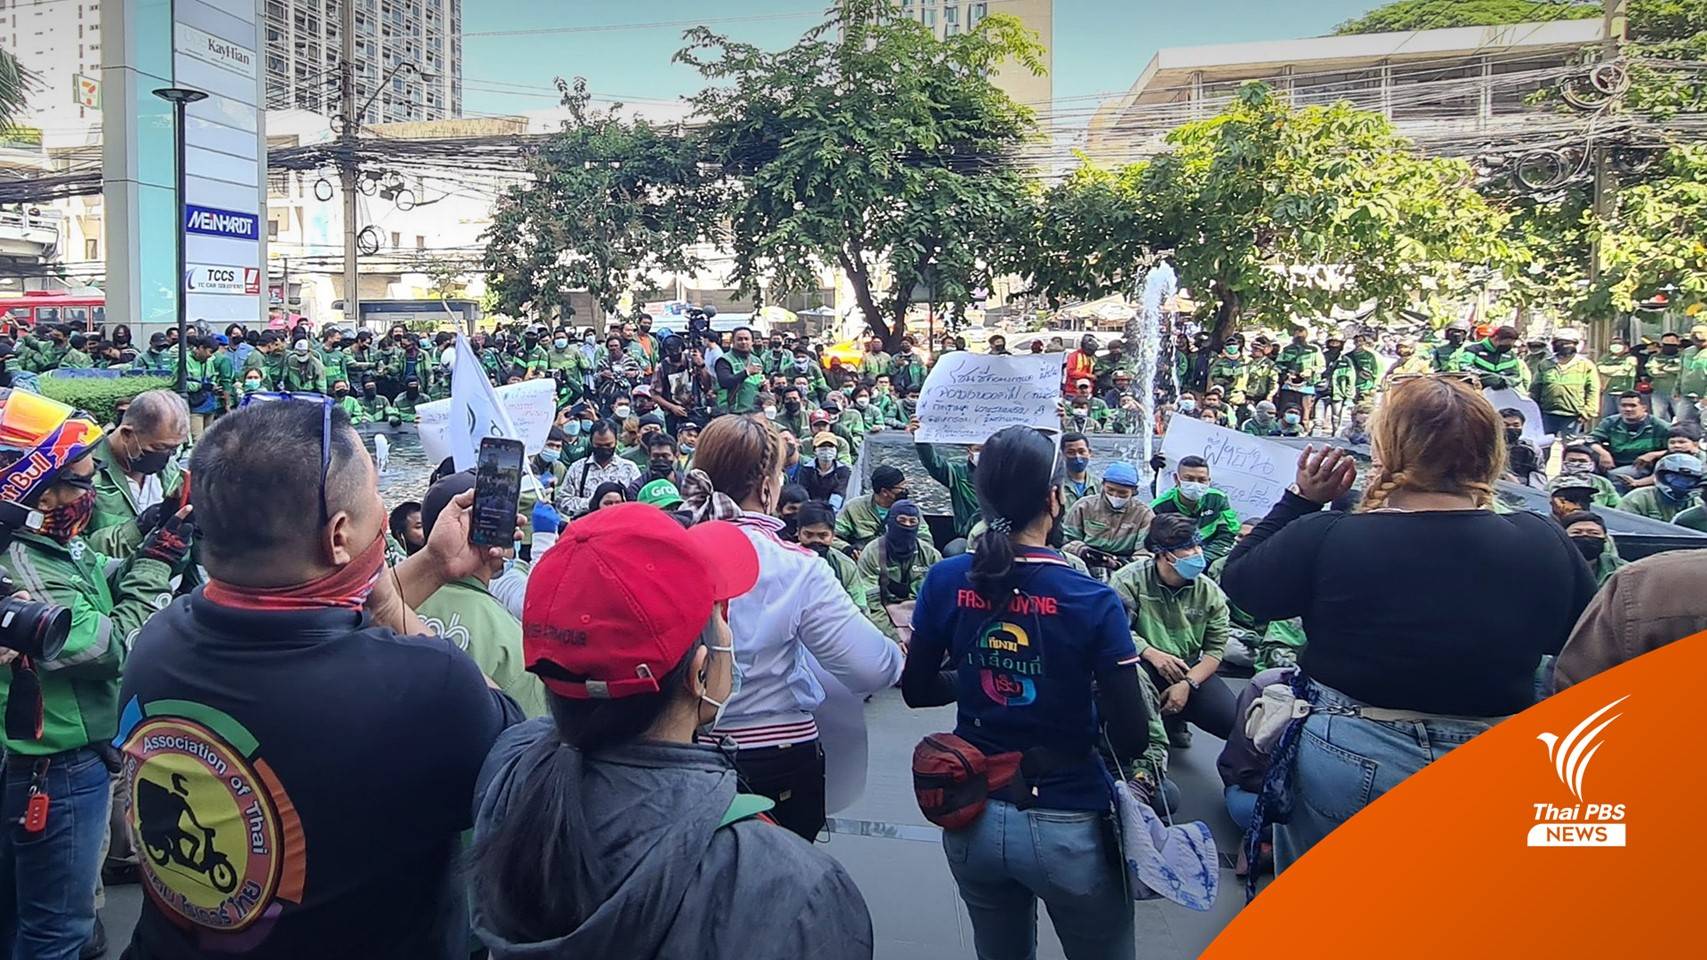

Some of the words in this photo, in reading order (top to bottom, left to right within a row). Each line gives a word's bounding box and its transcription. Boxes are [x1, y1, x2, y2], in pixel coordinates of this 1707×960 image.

[208, 38, 250, 65] KayHian
[207, 269, 235, 282] TCCS
[7, 451, 53, 492] Bull
[143, 736, 228, 776] Association
[230, 776, 252, 797] of
[244, 800, 268, 856] Thai
